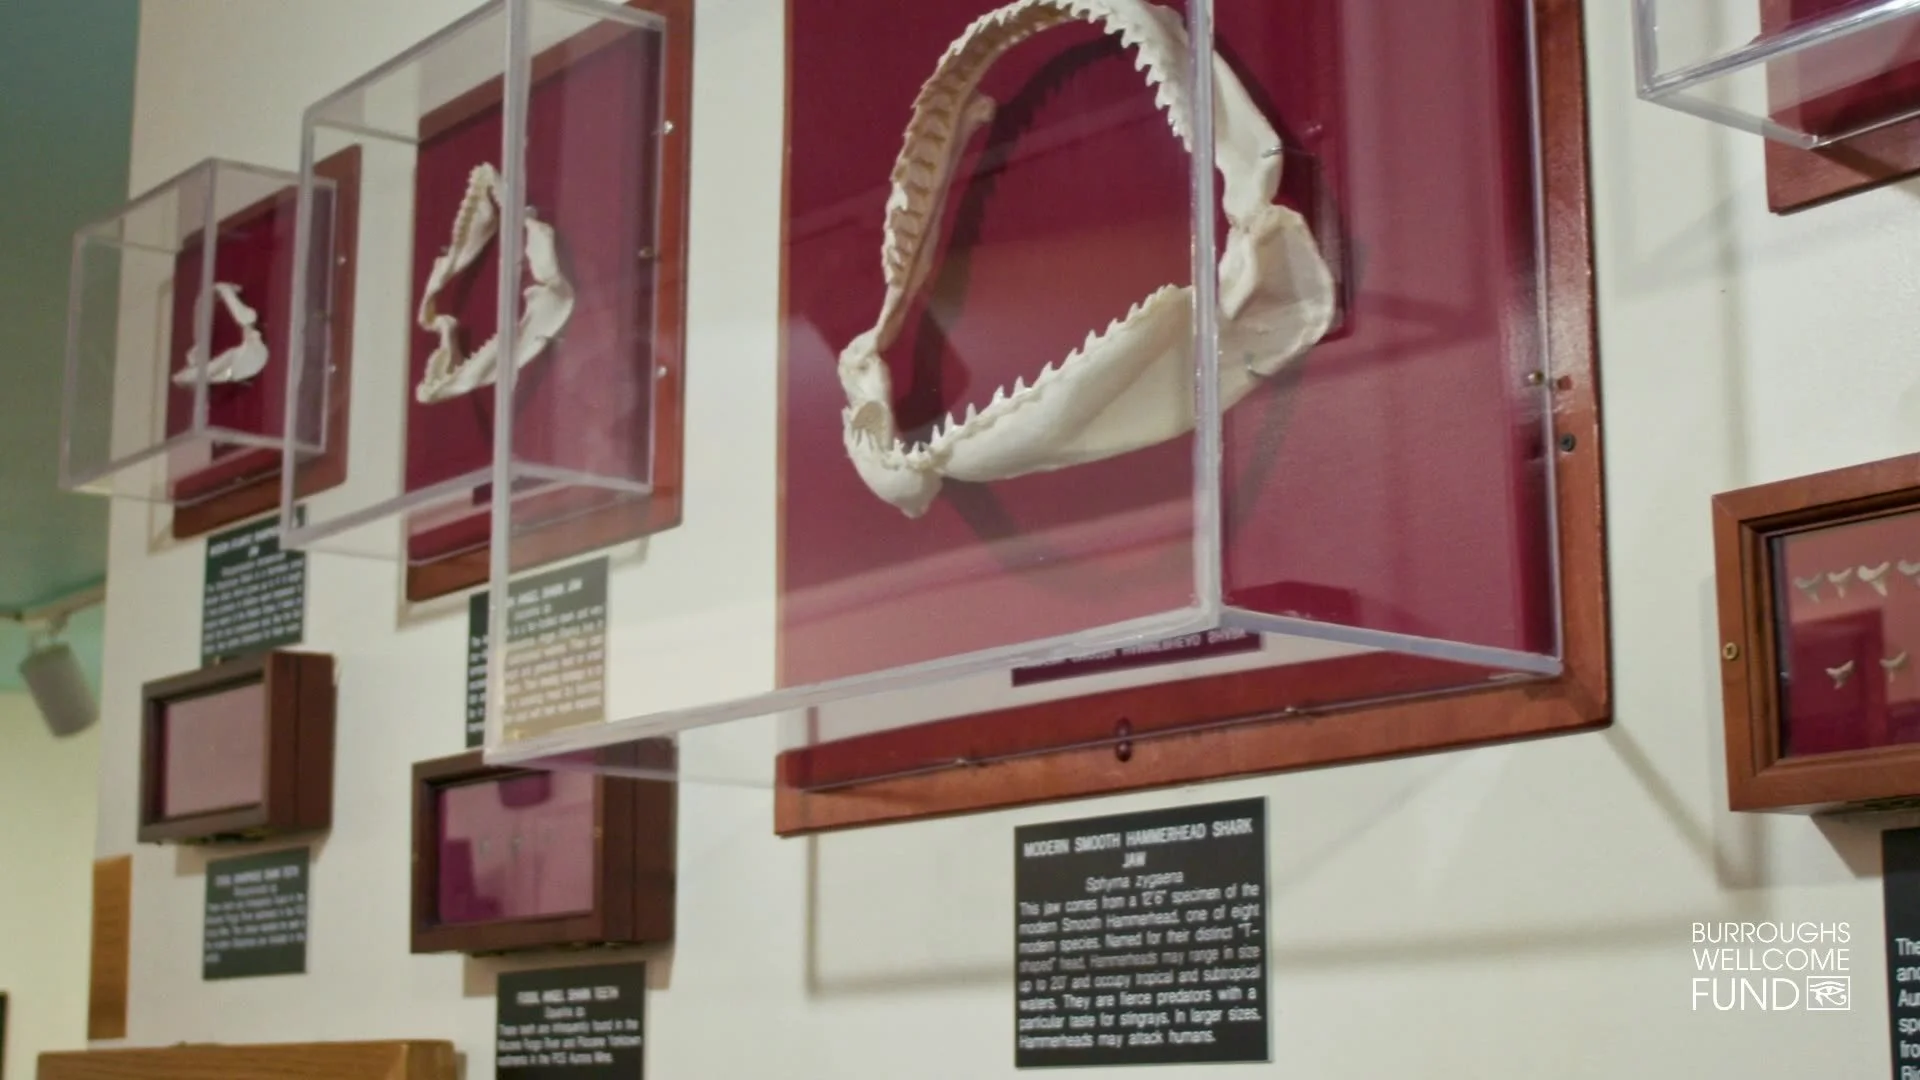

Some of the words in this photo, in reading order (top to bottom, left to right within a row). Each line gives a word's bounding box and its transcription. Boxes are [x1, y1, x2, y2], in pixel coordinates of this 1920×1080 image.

[1023, 838, 1070, 857] MODERN
[1074, 832, 1121, 852] SMOOTH
[1125, 822, 1206, 847] HAMMERHEAD
[1211, 817, 1253, 837] SHARK
[1122, 851, 1147, 868] JAW
[1019, 902, 1040, 916] This
[1043, 902, 1062, 916] jaw
[1065, 899, 1098, 912] comes
[1102, 895, 1125, 909] from
[1128, 896, 1138, 907] a
[1171, 888, 1221, 905] specimen
[1224, 882, 1238, 899] of
[1241, 881, 1260, 897] the
[1019, 921, 1059, 937] modern
[1062, 917, 1102, 933] Smooth
[1185, 908, 1208, 922] one
[1212, 904, 1227, 920] of
[1230, 902, 1260, 921] eight
[1019, 940, 1056, 954] modern
[1105, 932, 1143, 948] Named
[1146, 929, 1162, 945] for
[1166, 928, 1190, 943] their
[1195, 922, 1233, 942] distinct
[1089, 950, 1159, 968] Hammerheads
[1161, 951, 1185, 966] may
[1188, 948, 1220, 965] range
[1222, 944, 1234, 960] in
[1237, 944, 1260, 960] size
[1019, 980, 1033, 993] up
[1035, 978, 1048, 992] to
[1071, 974, 1091, 989] and
[1094, 974, 1131, 989] occupy
[1135, 968, 1174, 986] tropical
[1178, 967, 1199, 983] and
[1202, 963, 1261, 982] subtropical
[1062, 993, 1092, 1011] They
[1095, 994, 1116, 1008] are
[1119, 990, 1152, 1007] fierce
[1156, 988, 1213, 1007] predators
[1216, 985, 1243, 1001] with
[1247, 986, 1258, 1000] a
[1019, 1014, 1065, 1031] particular
[1068, 1014, 1096, 1028] taste
[1099, 1011, 1116, 1027] for
[1174, 1008, 1187, 1024] In
[1190, 1007, 1223, 1026] larger
[1019, 1033, 1093, 1049] Hammerheads
[1097, 1034, 1124, 1049] may
[1128, 1029, 1165, 1046] attack
[1167, 1028, 1217, 1045] humans.
